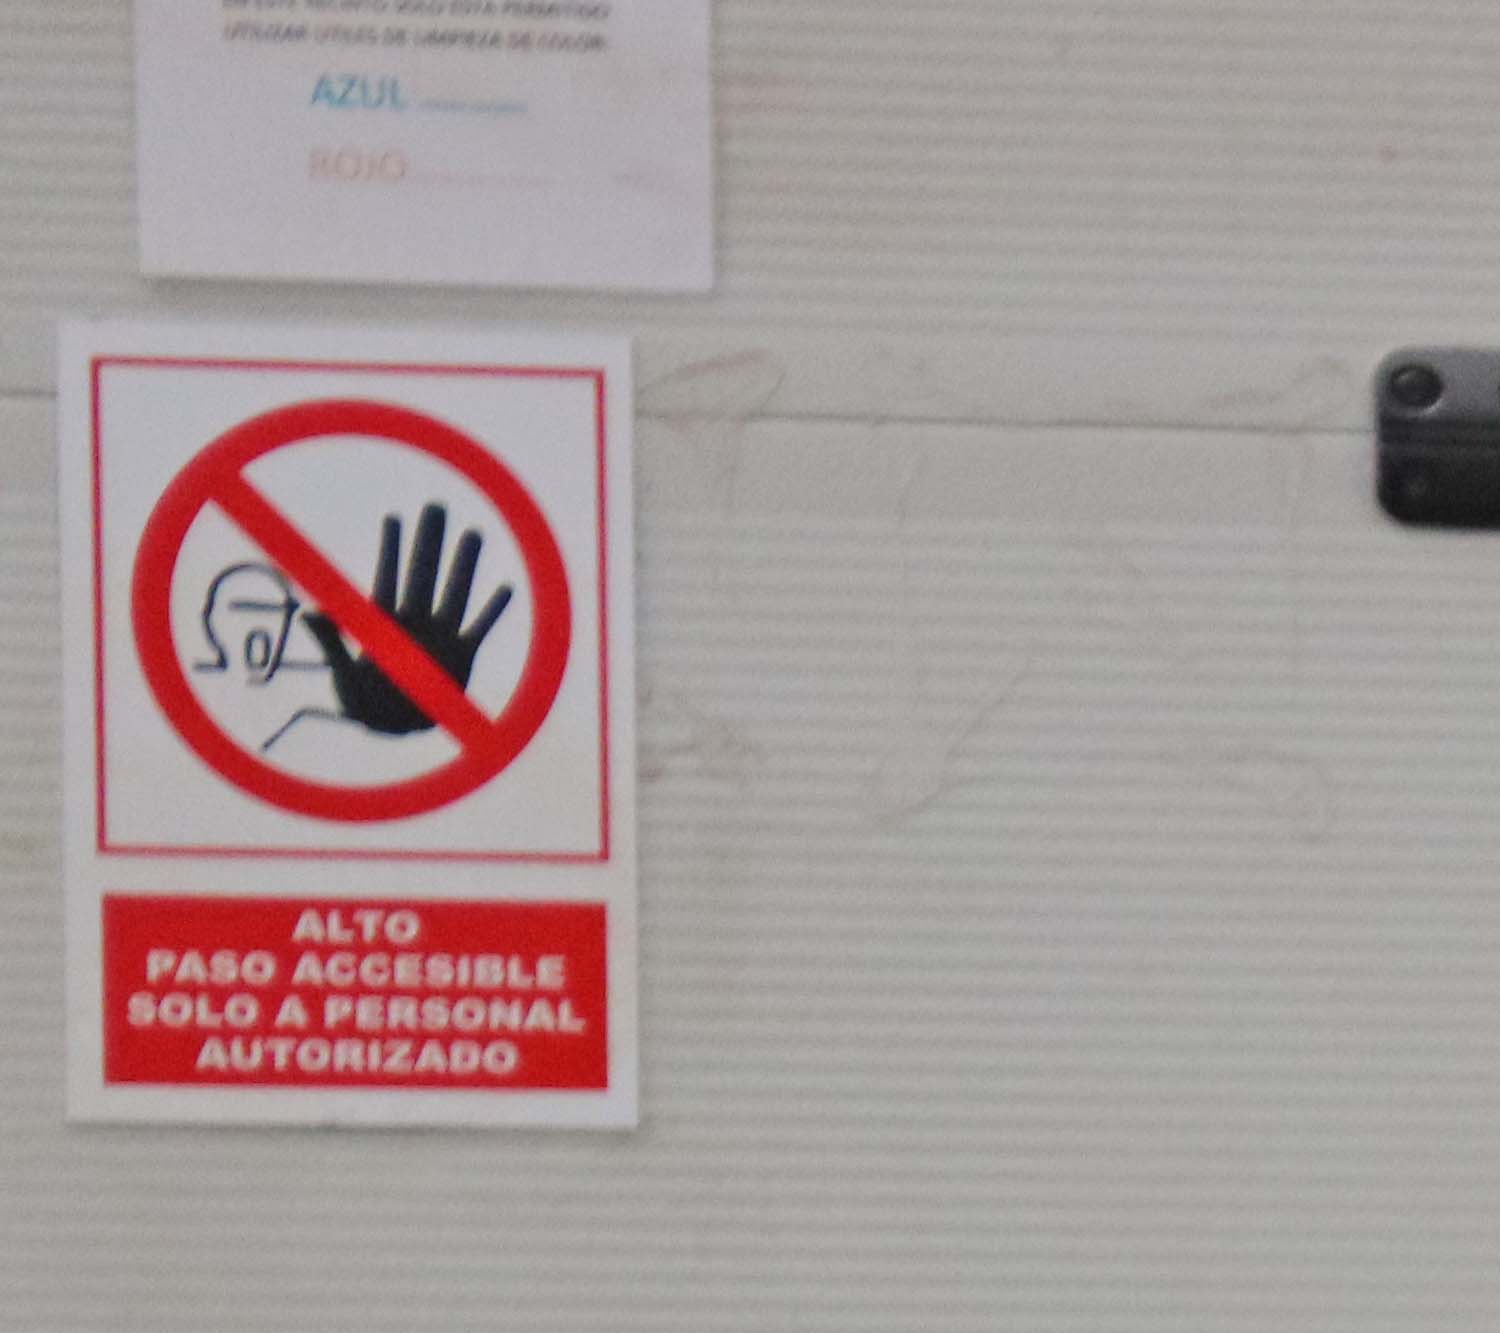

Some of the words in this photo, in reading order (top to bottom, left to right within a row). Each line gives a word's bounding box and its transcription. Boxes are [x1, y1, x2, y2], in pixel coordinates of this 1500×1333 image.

[311, 74, 408, 110] AZUL
[309, 149, 407, 183] ROJO
[292, 909, 421, 944] ALTO
[145, 949, 276, 987] PASO
[292, 952, 566, 990] ACCESIBLE
[127, 991, 259, 1028] SOLO
[274, 994, 309, 1028] A
[324, 994, 586, 1034] PERSONAL
[195, 1036, 519, 1075] AUTORIZADO
